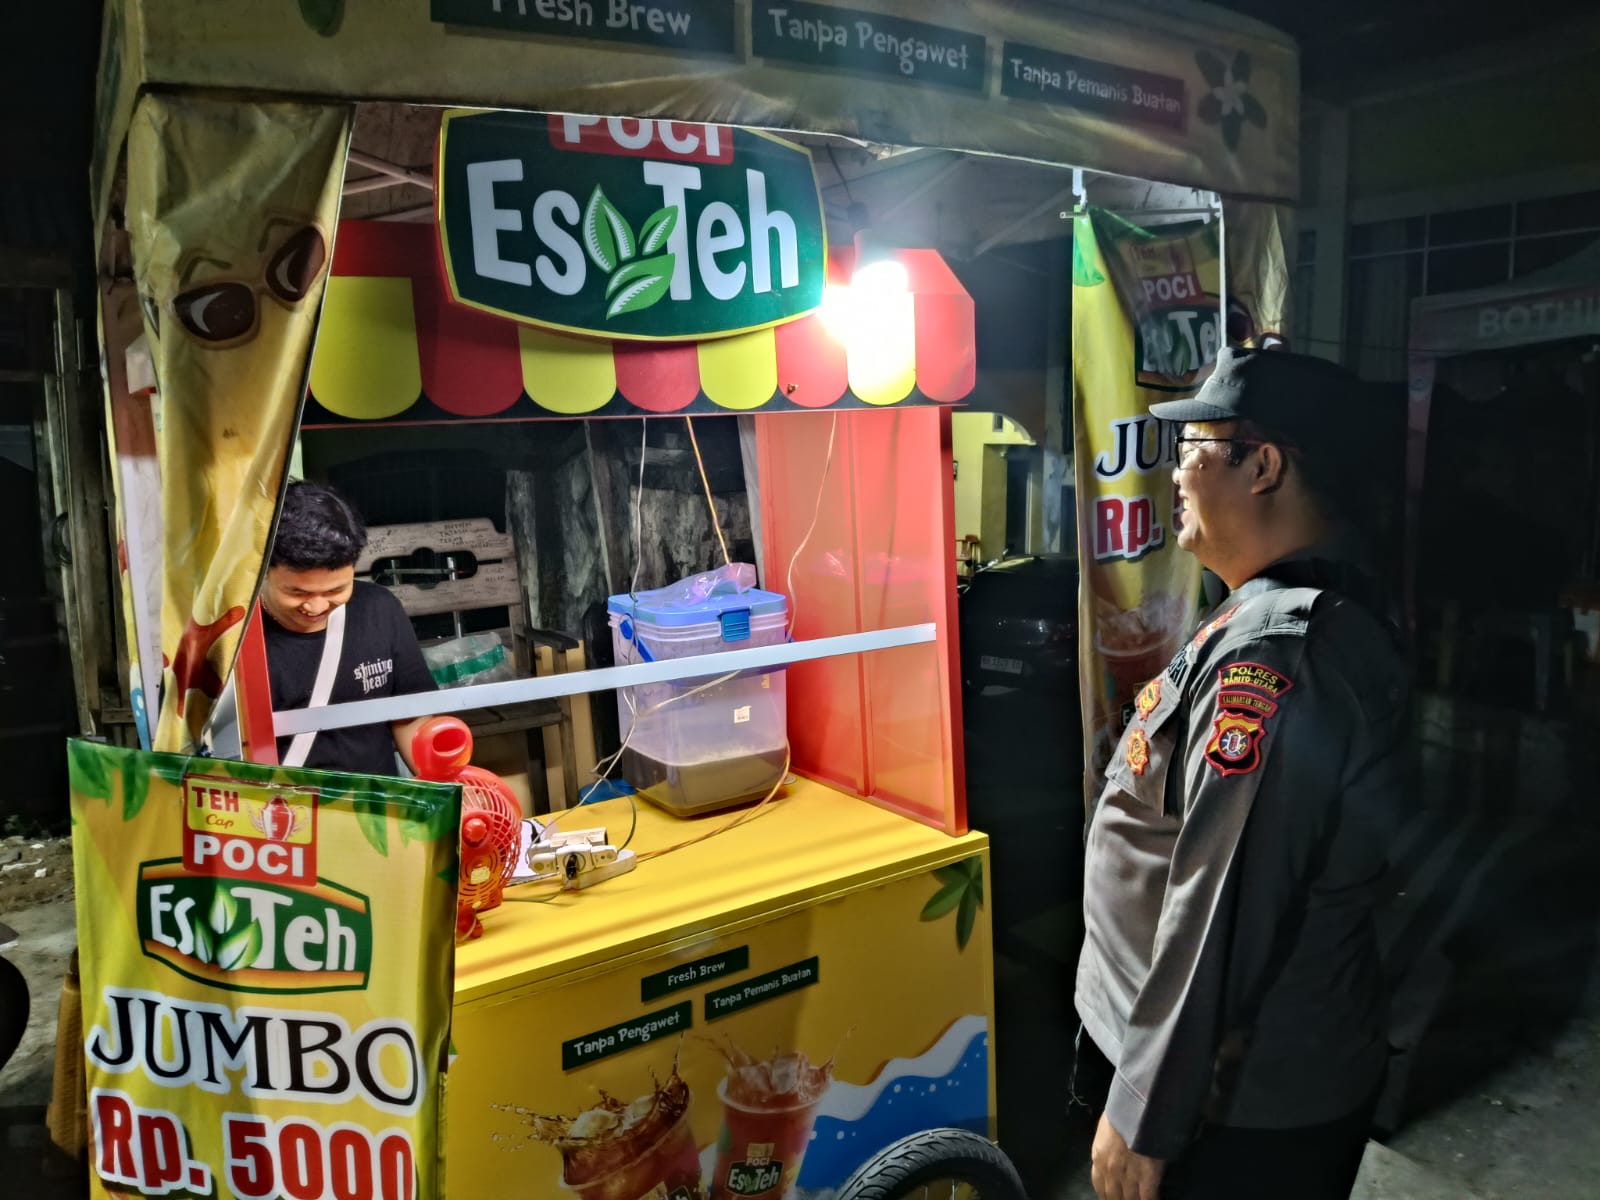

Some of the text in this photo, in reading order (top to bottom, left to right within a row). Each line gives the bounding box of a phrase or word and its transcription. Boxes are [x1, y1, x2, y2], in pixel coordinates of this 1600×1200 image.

[606, 0, 691, 35] Brew
[768, 8, 969, 74] Tanpa Pengawet
[1010, 58, 1181, 114] Tanpa Pemanis Buatan
[466, 158, 800, 301] Es Teh
[1142, 274, 1197, 302] POCI
[1097, 498, 1160, 553] Rp.
[1230, 666, 1278, 685] POLRES
[191, 786, 240, 813] TEH
[205, 814, 234, 829] Cap
[193, 834, 304, 878] POCI
[150, 884, 357, 972] Es Teh
[667, 960, 726, 986] Fresh Brew
[713, 967, 812, 1010] Tanpa Pemanis Buatan
[91, 995, 418, 1106] JUMBO
[573, 1011, 681, 1057] Tanpa Pengawet
[96, 1094, 414, 1200] Rp. 5000
[728, 1165, 779, 1191] Es Teh
